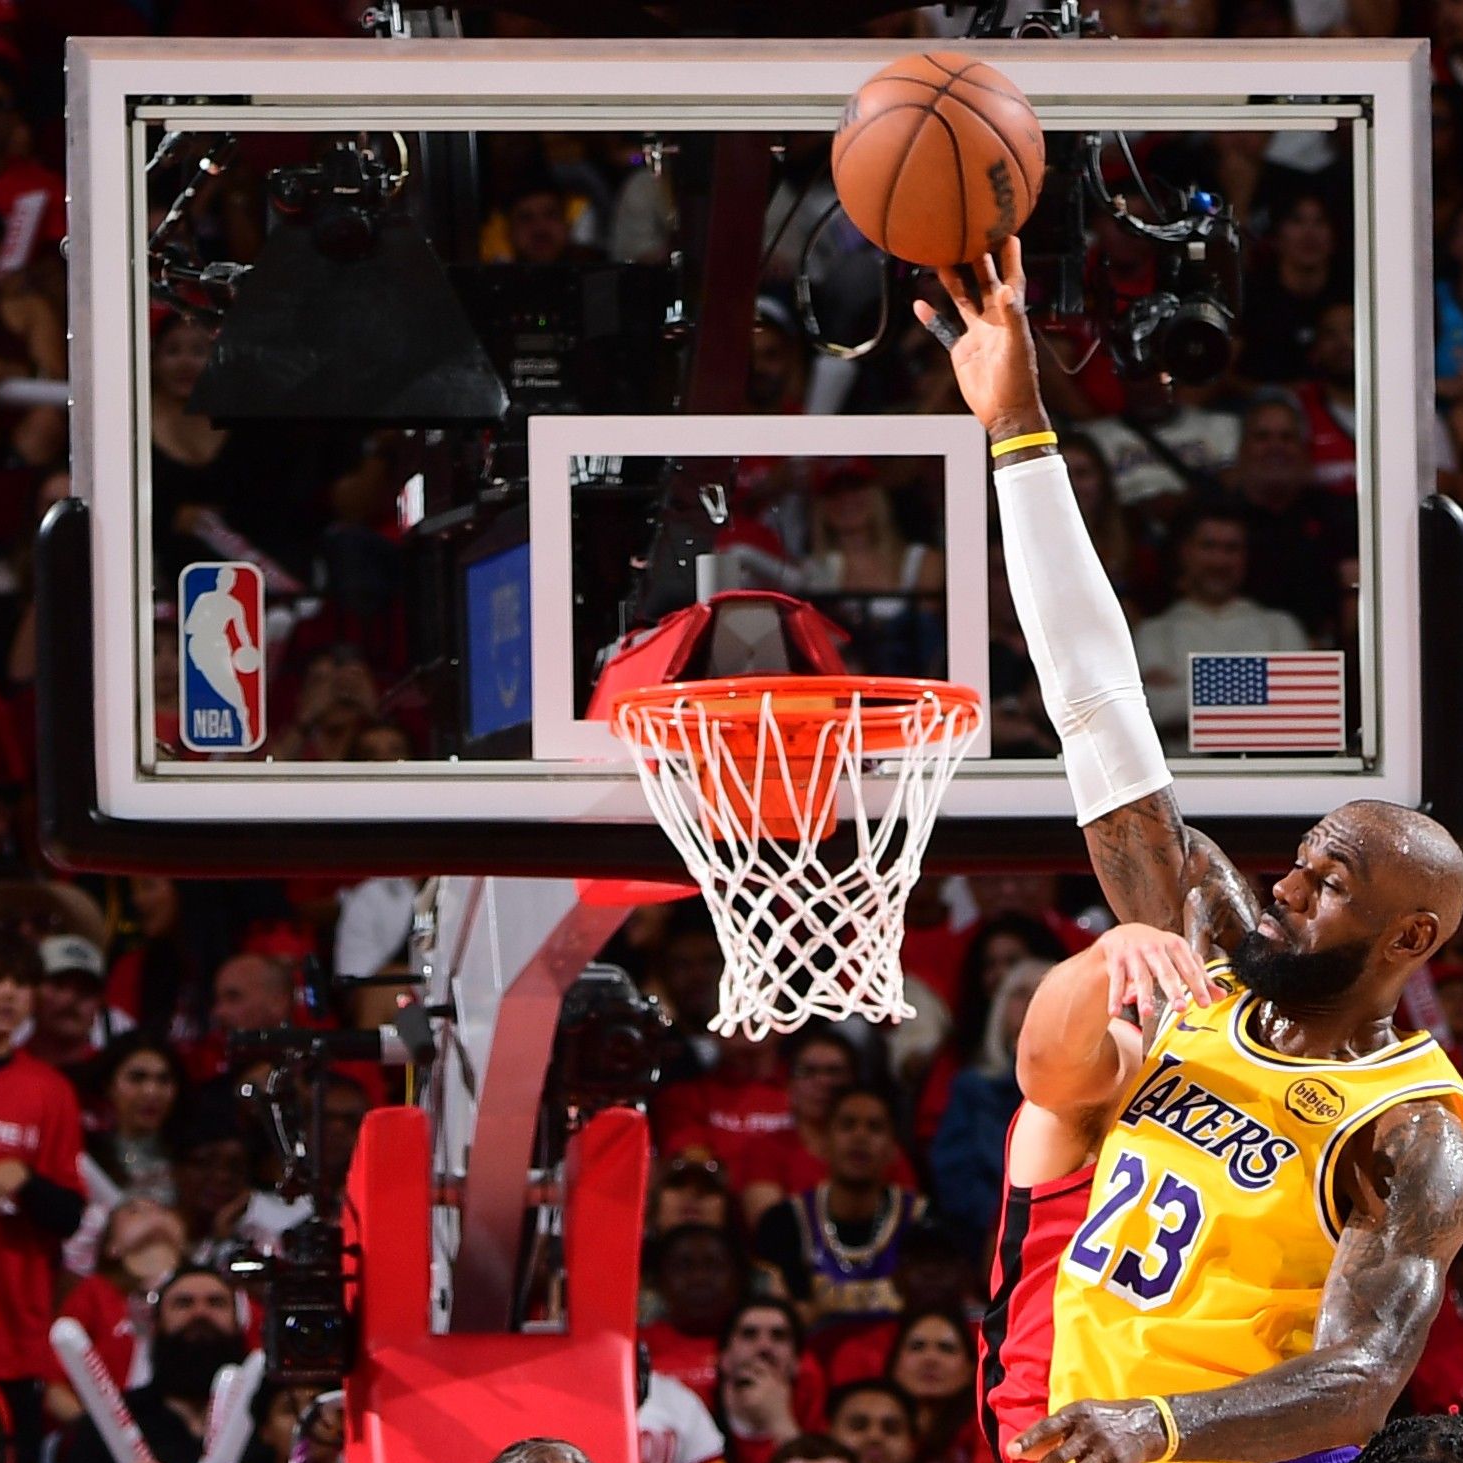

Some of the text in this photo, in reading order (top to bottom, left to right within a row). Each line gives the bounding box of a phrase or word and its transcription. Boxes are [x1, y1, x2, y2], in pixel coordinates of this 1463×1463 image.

[193, 708, 234, 738] NBA
[1120, 1052, 1298, 1191] LAKERS
[1294, 1082, 1337, 1117] bibigo
[1064, 1150, 1204, 1309] 23
